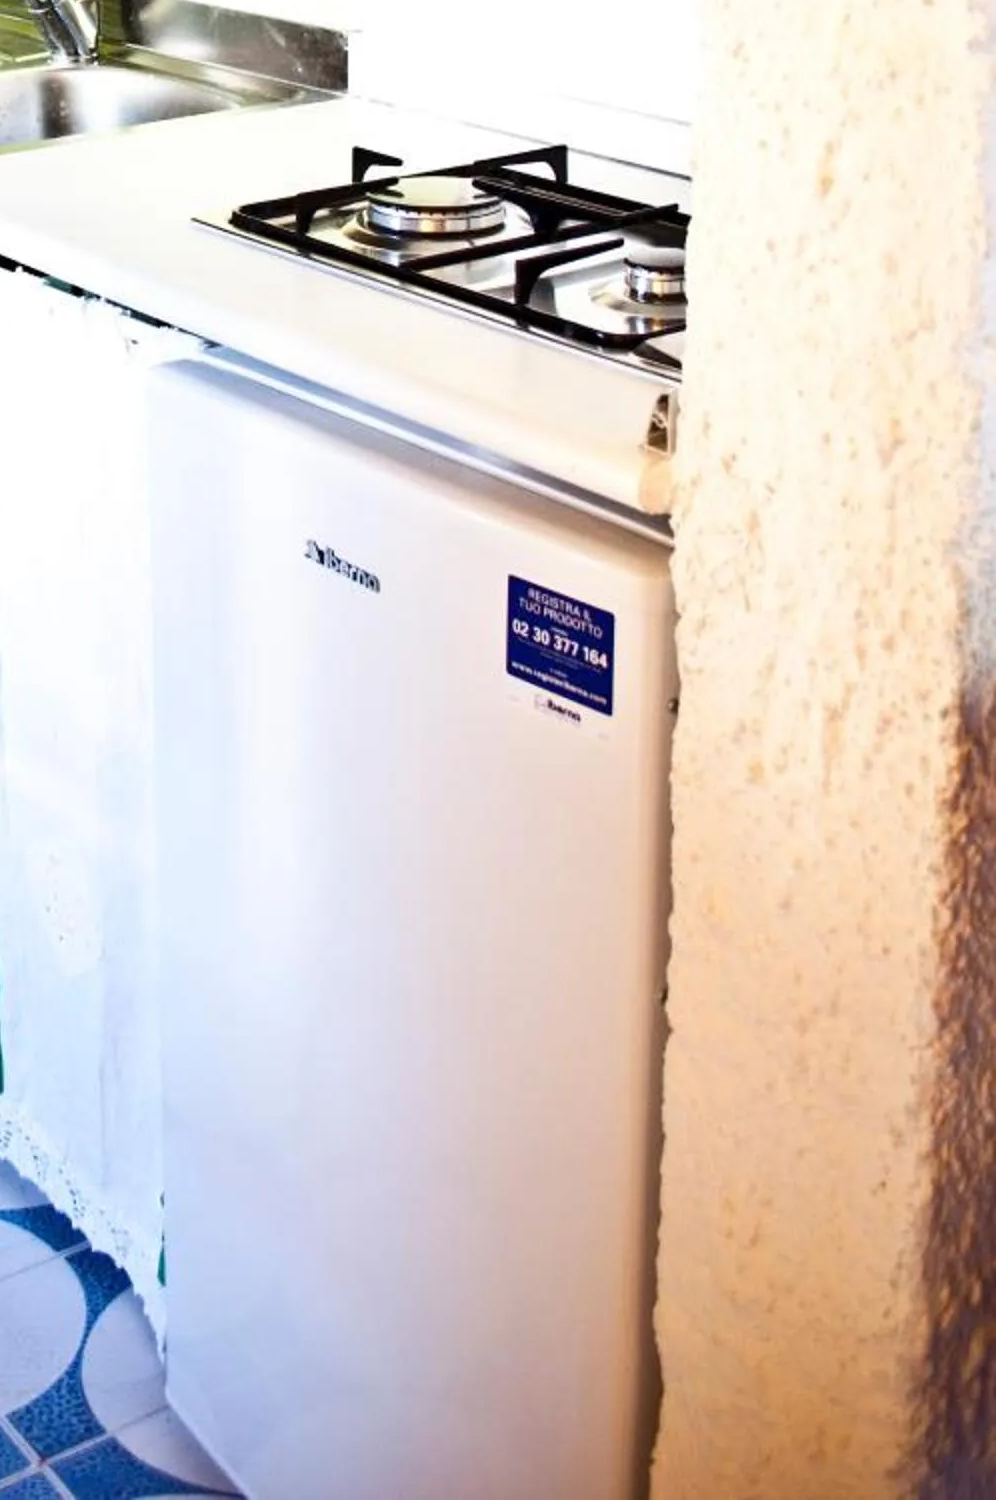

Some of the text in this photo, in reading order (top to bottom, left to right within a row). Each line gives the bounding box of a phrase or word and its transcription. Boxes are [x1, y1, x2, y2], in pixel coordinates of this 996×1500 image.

[519, 596, 541, 615] TUO
[543, 608, 603, 639] PRODOTTO
[527, 587, 581, 616] REGISTRA
[511, 617, 529, 637] 02
[532, 626, 550, 645] 30
[553, 634, 579, 657] 377
